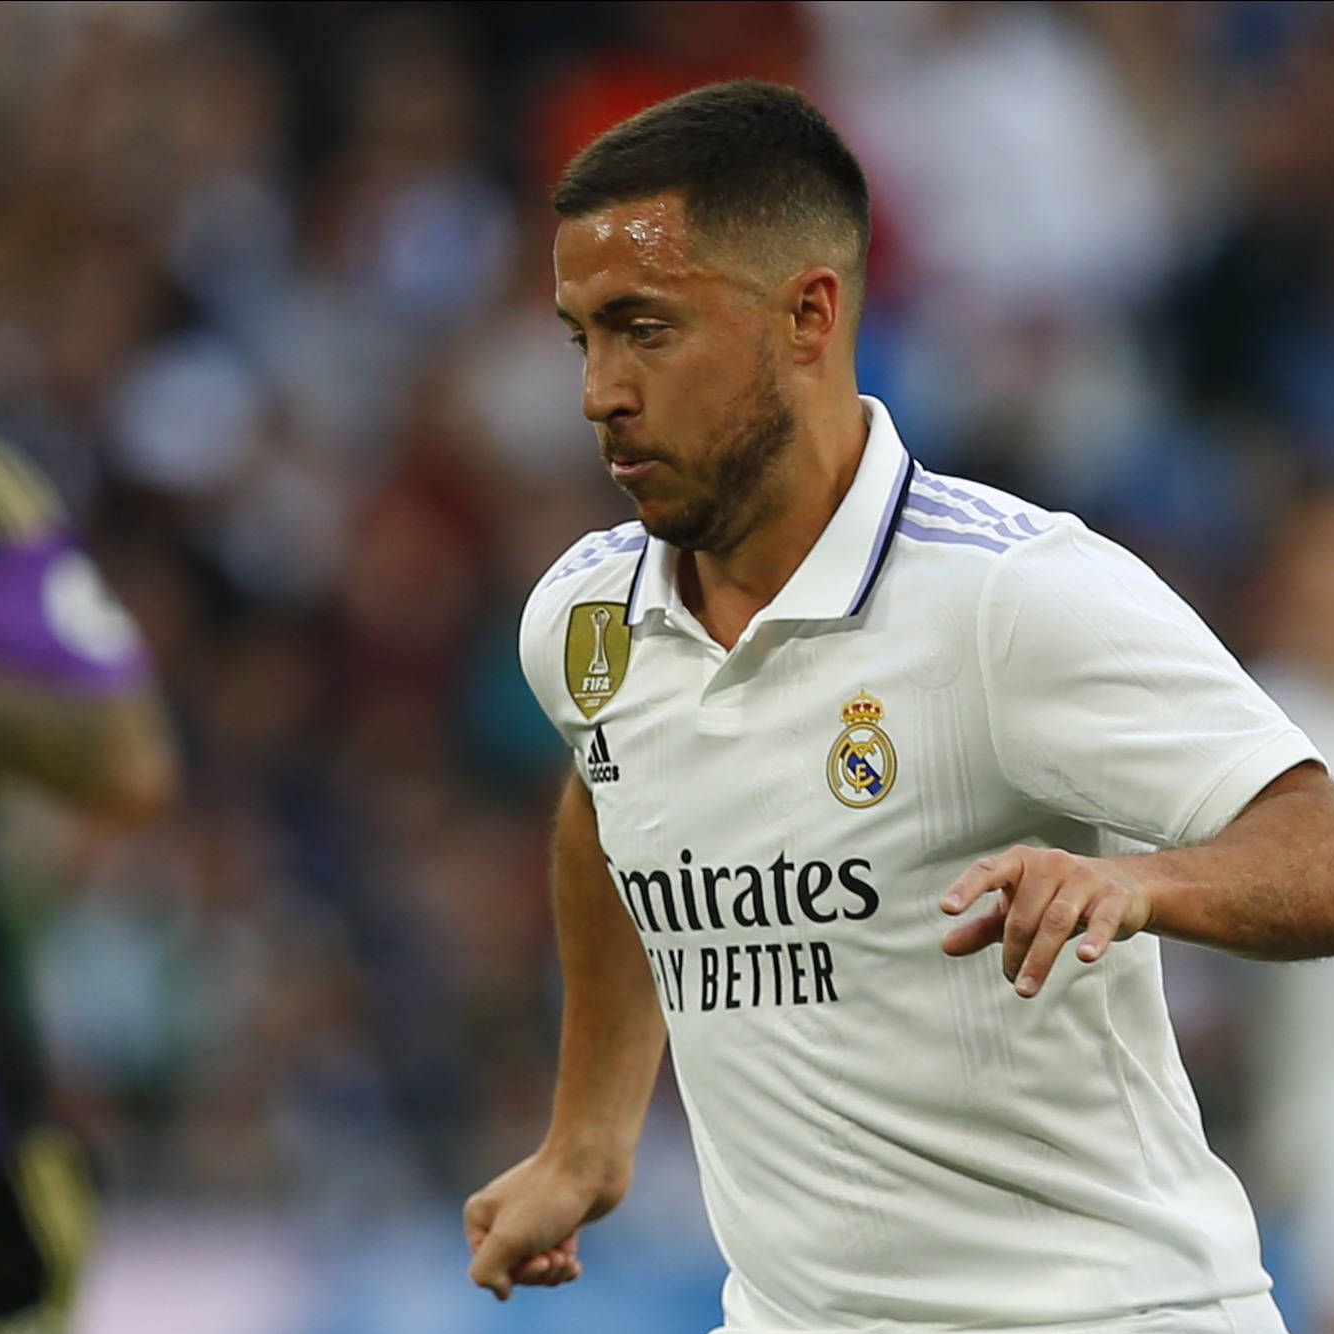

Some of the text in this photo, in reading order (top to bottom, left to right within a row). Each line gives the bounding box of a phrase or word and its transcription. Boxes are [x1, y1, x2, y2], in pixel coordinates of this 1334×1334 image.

[582, 676, 610, 691] FIFA
[605, 849, 880, 932] mirates
[649, 941, 839, 1012] LY BETTER
